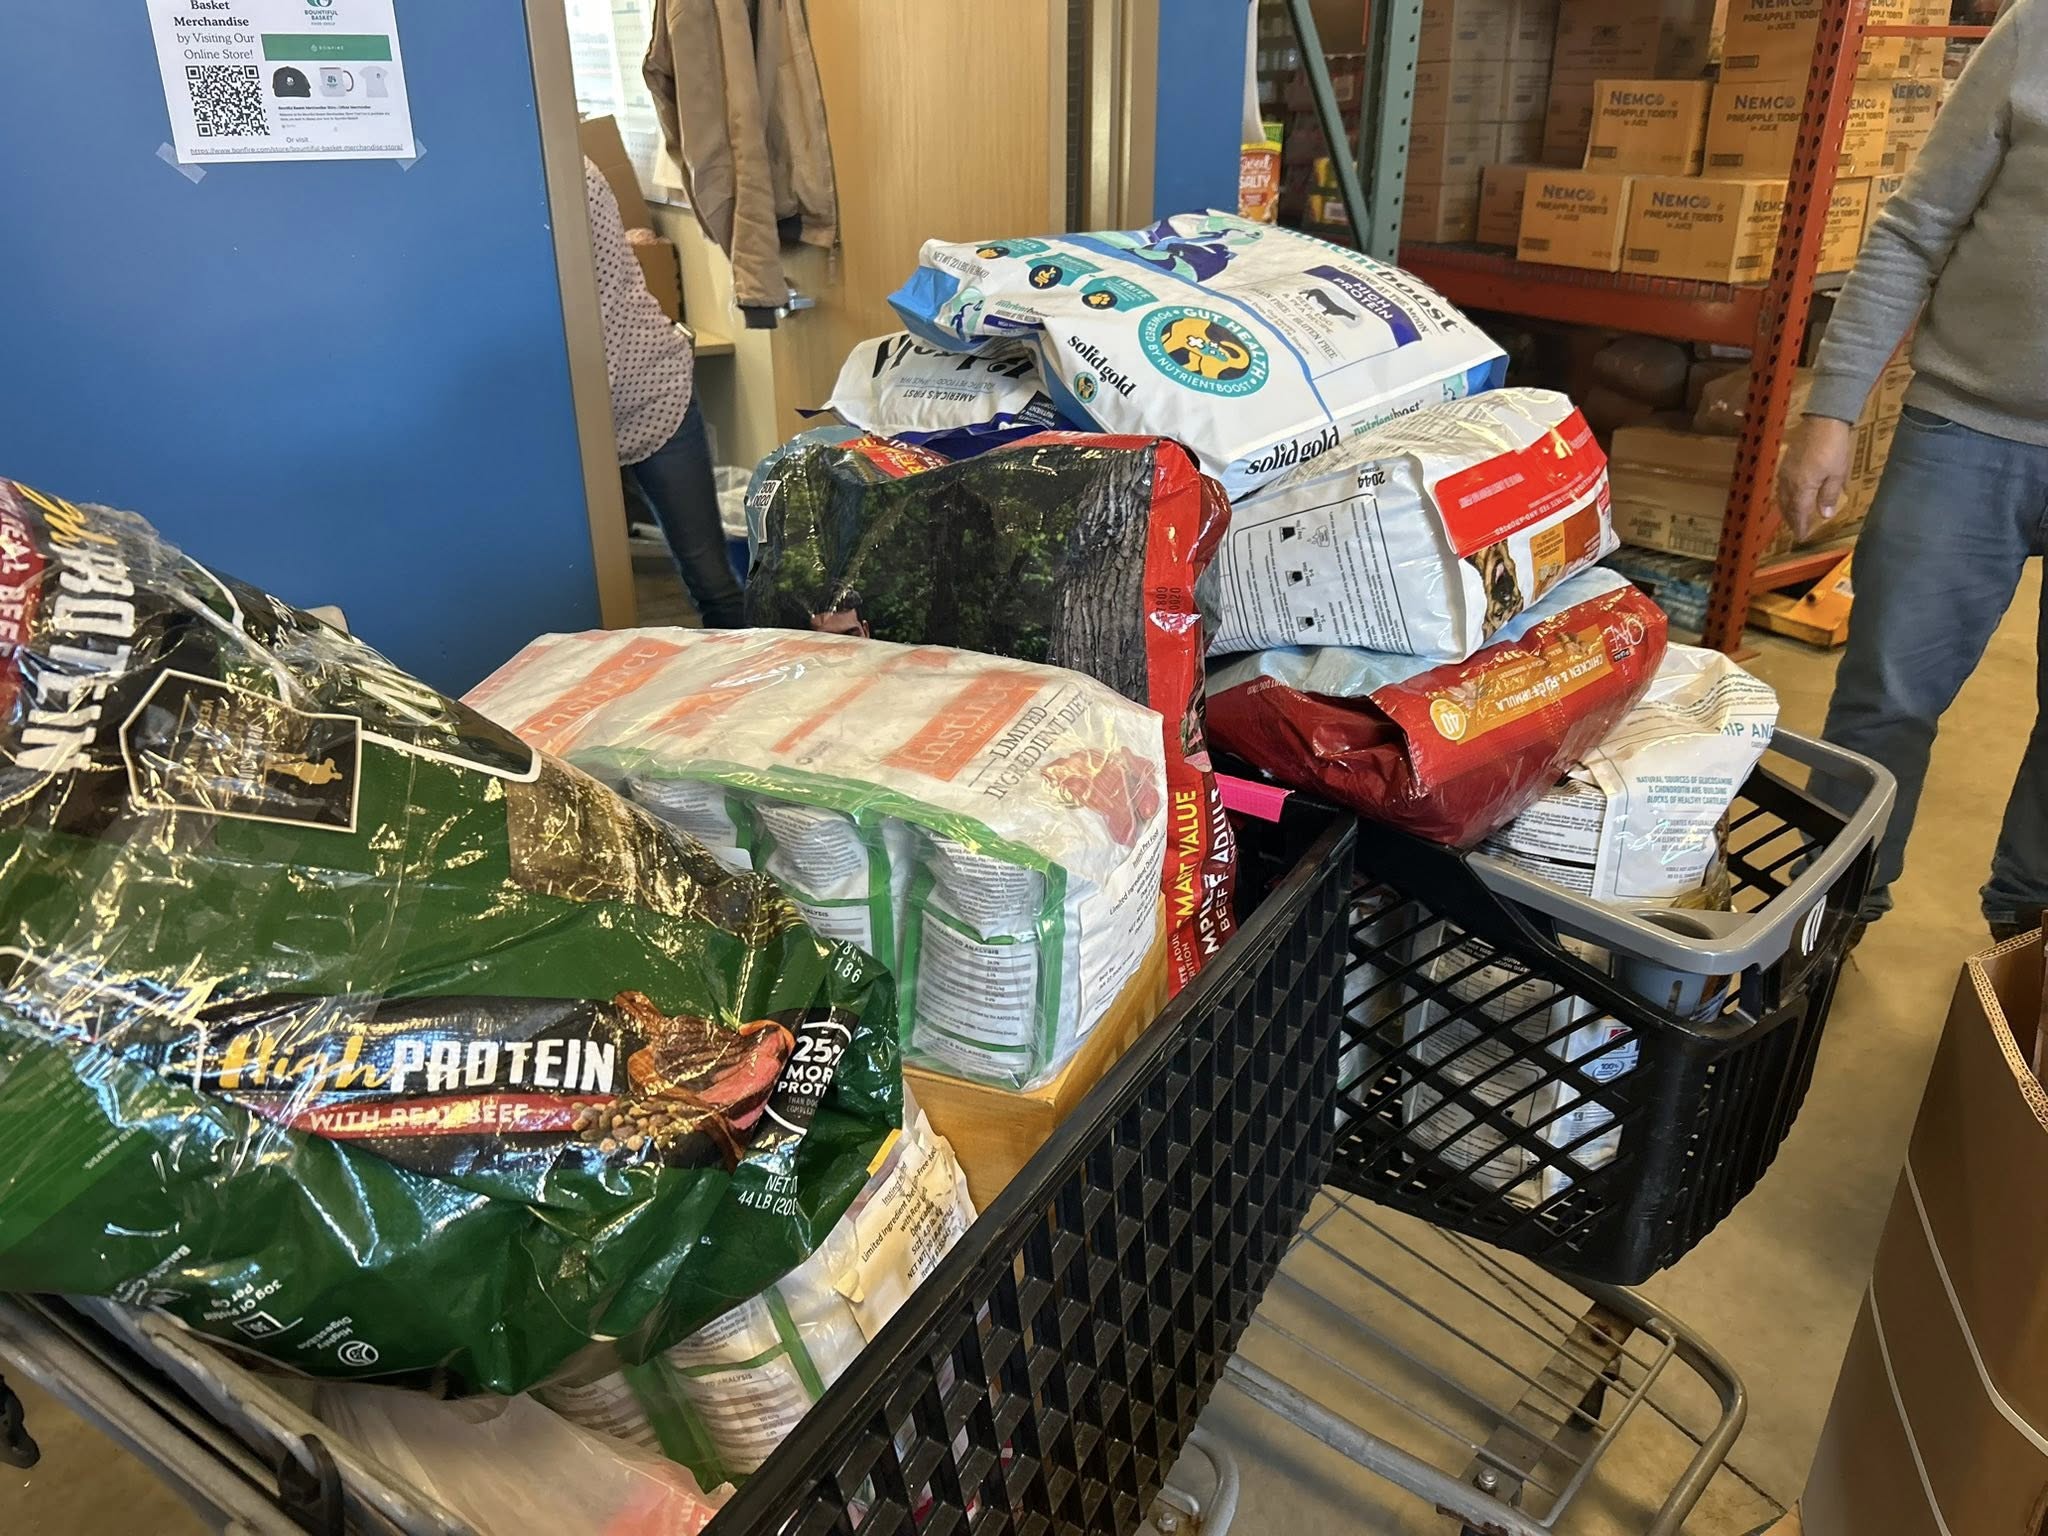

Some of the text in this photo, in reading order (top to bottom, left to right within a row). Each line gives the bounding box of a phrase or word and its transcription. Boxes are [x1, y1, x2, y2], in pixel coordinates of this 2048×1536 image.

[191, 0, 230, 10] Basket
[173, 16, 249, 27] Merchandise
[1743, 11, 1792, 22] PINEAPPLE
[177, 33, 255, 45] by Visiting Our
[184, 49, 253, 60] Online Store!
[1610, 90, 1665, 105] NEMCO
[1734, 95, 1796, 110] NEMCO
[1850, 99, 1876, 110] EMCO
[1603, 108, 1678, 119] PINEAPPLE TIDBITS
[1727, 113, 1773, 123] PINEAPPLE
[1542, 185, 1595, 201] NEMCO
[1652, 192, 1711, 209] NEMCO
[1536, 201, 1608, 215] PINEAPPLE TIDBITS
[1643, 209, 1724, 223] PINEAPPLE TIDBITS
[1754, 200, 1785, 213] NEMC
[1117, 278, 1151, 299] THRIVE
[1353, 282, 1391, 308] HIGH
[1332, 277, 1393, 320] PROTEIN
[1145, 311, 1251, 393] POWERED BY NUTRIENTBOOST
[1183, 308, 1222, 322] GUT
[1225, 322, 1266, 381] HEALTH
[1067, 335, 1103, 372] solid
[1098, 365, 1138, 399] gold
[902, 388, 975, 402] AMERICA'S FIRST
[1245, 425, 1340, 475] solid gold
[1358, 471, 1386, 489] 2044
[15, 541, 135, 772] PROTEIN
[1567, 655, 1604, 677] CHICKEN
[1559, 670, 1569, 682] &
[1439, 708, 1462, 735] 40
[990, 705, 1048, 759] LIMITED
[984, 690, 1092, 800] INGREDIENT DIET
[1175, 790, 1200, 858] VALUE
[964, 943, 999, 955] ANALYSIS
[833, 956, 863, 985] 186
[218, 1035, 616, 1112] High PROTEIN
[786, 1064, 833, 1085] MOR
[777, 1081, 827, 1099] PROT
[308, 1108, 380, 1132] WITH
[765, 1174, 788, 1193] NET
[738, 1190, 772, 1209] 44 LB
[861, 1235, 884, 1262] Limited
[881, 1200, 908, 1238] Ingredient
[906, 1188, 918, 1205] Diet
[899, 1201, 922, 1233] with Real
[907, 1263, 919, 1280] NET
[230, 1282, 256, 1302] Per
